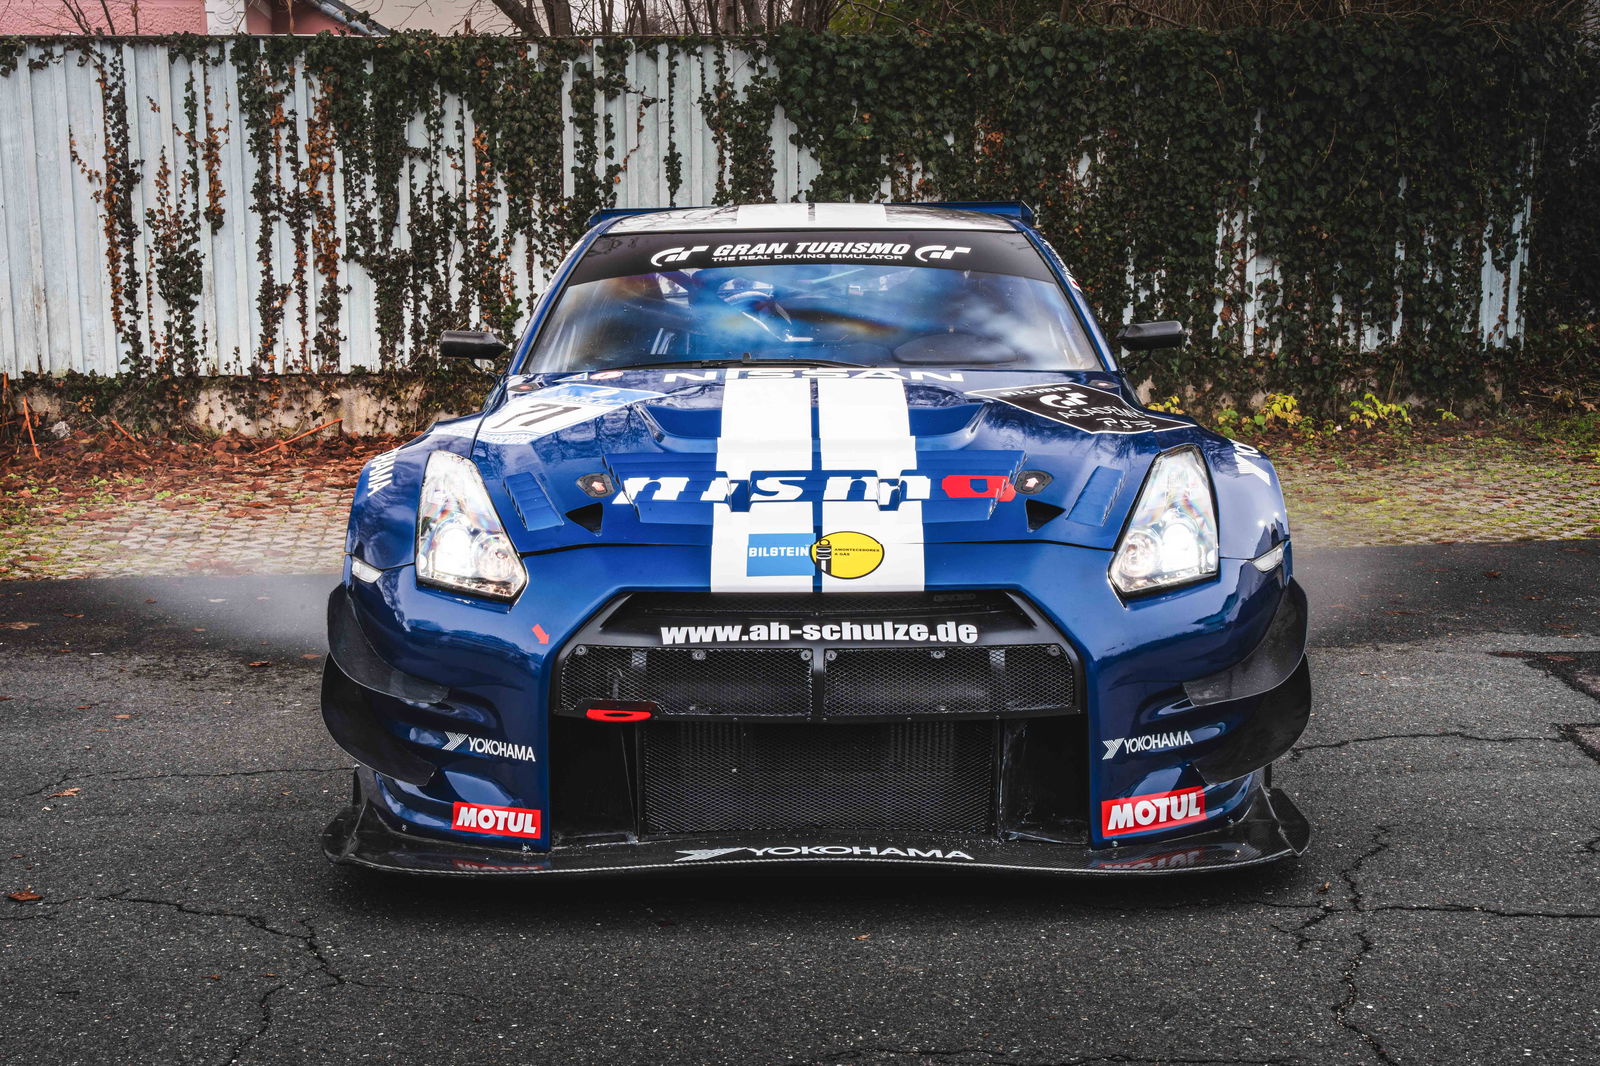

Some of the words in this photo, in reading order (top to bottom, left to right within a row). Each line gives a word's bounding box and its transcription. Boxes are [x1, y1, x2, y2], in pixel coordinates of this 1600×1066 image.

[713, 243, 788, 256] GRAN
[797, 242, 911, 254] TURISMO
[663, 367, 965, 382] NISSAN
[491, 403, 582, 429] 71
[612, 475, 1017, 505] nismo
[748, 546, 809, 557] BILSTEIN
[660, 621, 978, 645] www.ah-schulze.de
[468, 736, 536, 762] YOKOHAMA
[1124, 730, 1193, 754] YOKOHAMA
[456, 806, 537, 834] MOTUL
[1107, 792, 1201, 831] MOTUL
[747, 846, 974, 860] YOKOHAMA
